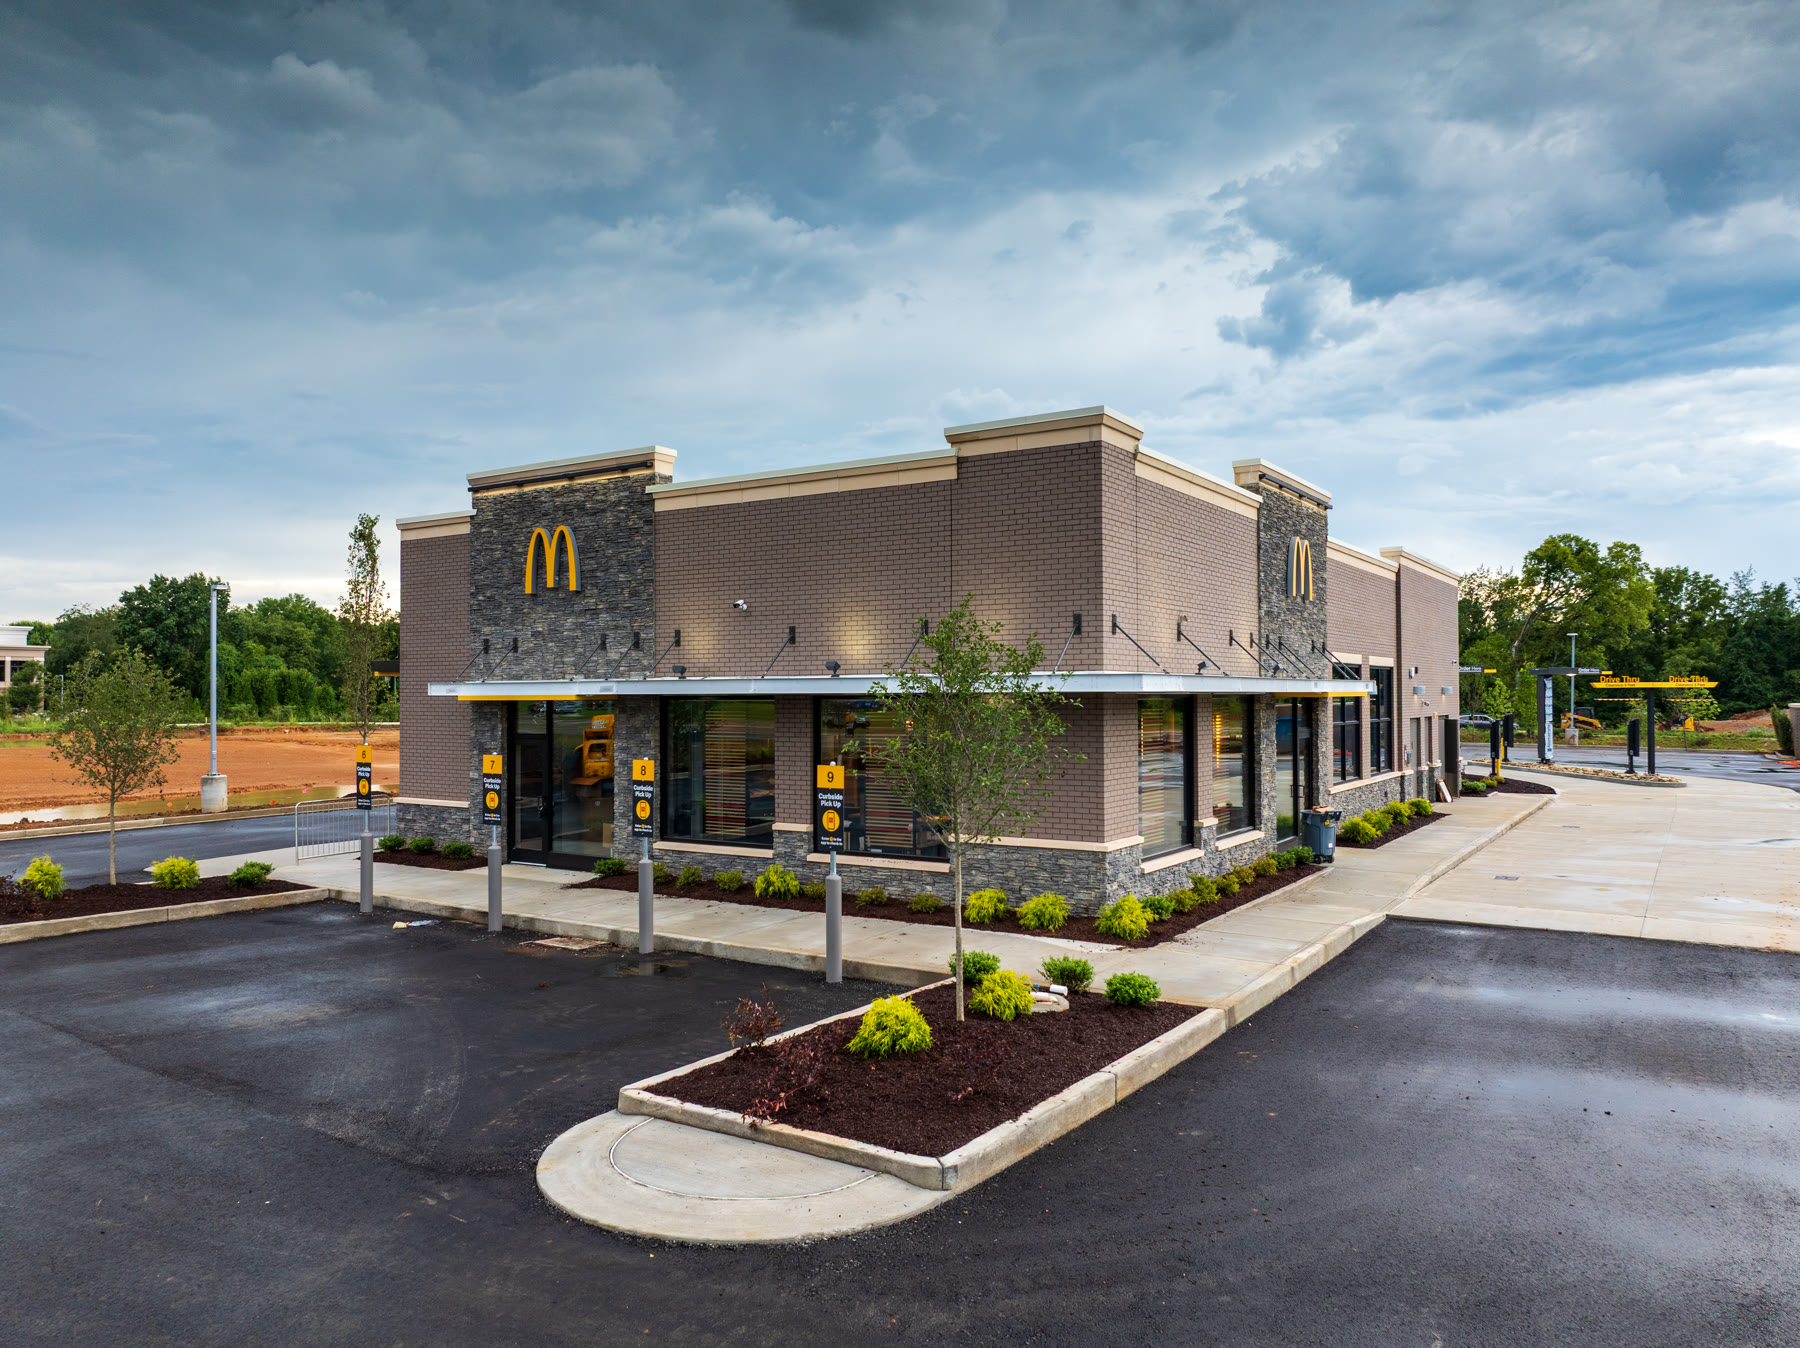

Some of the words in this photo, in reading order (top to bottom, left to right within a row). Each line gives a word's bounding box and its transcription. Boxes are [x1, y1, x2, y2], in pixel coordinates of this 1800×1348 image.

[490, 760, 495, 770] 7
[640, 765, 646, 776] 8
[827, 771, 834, 783] 9
